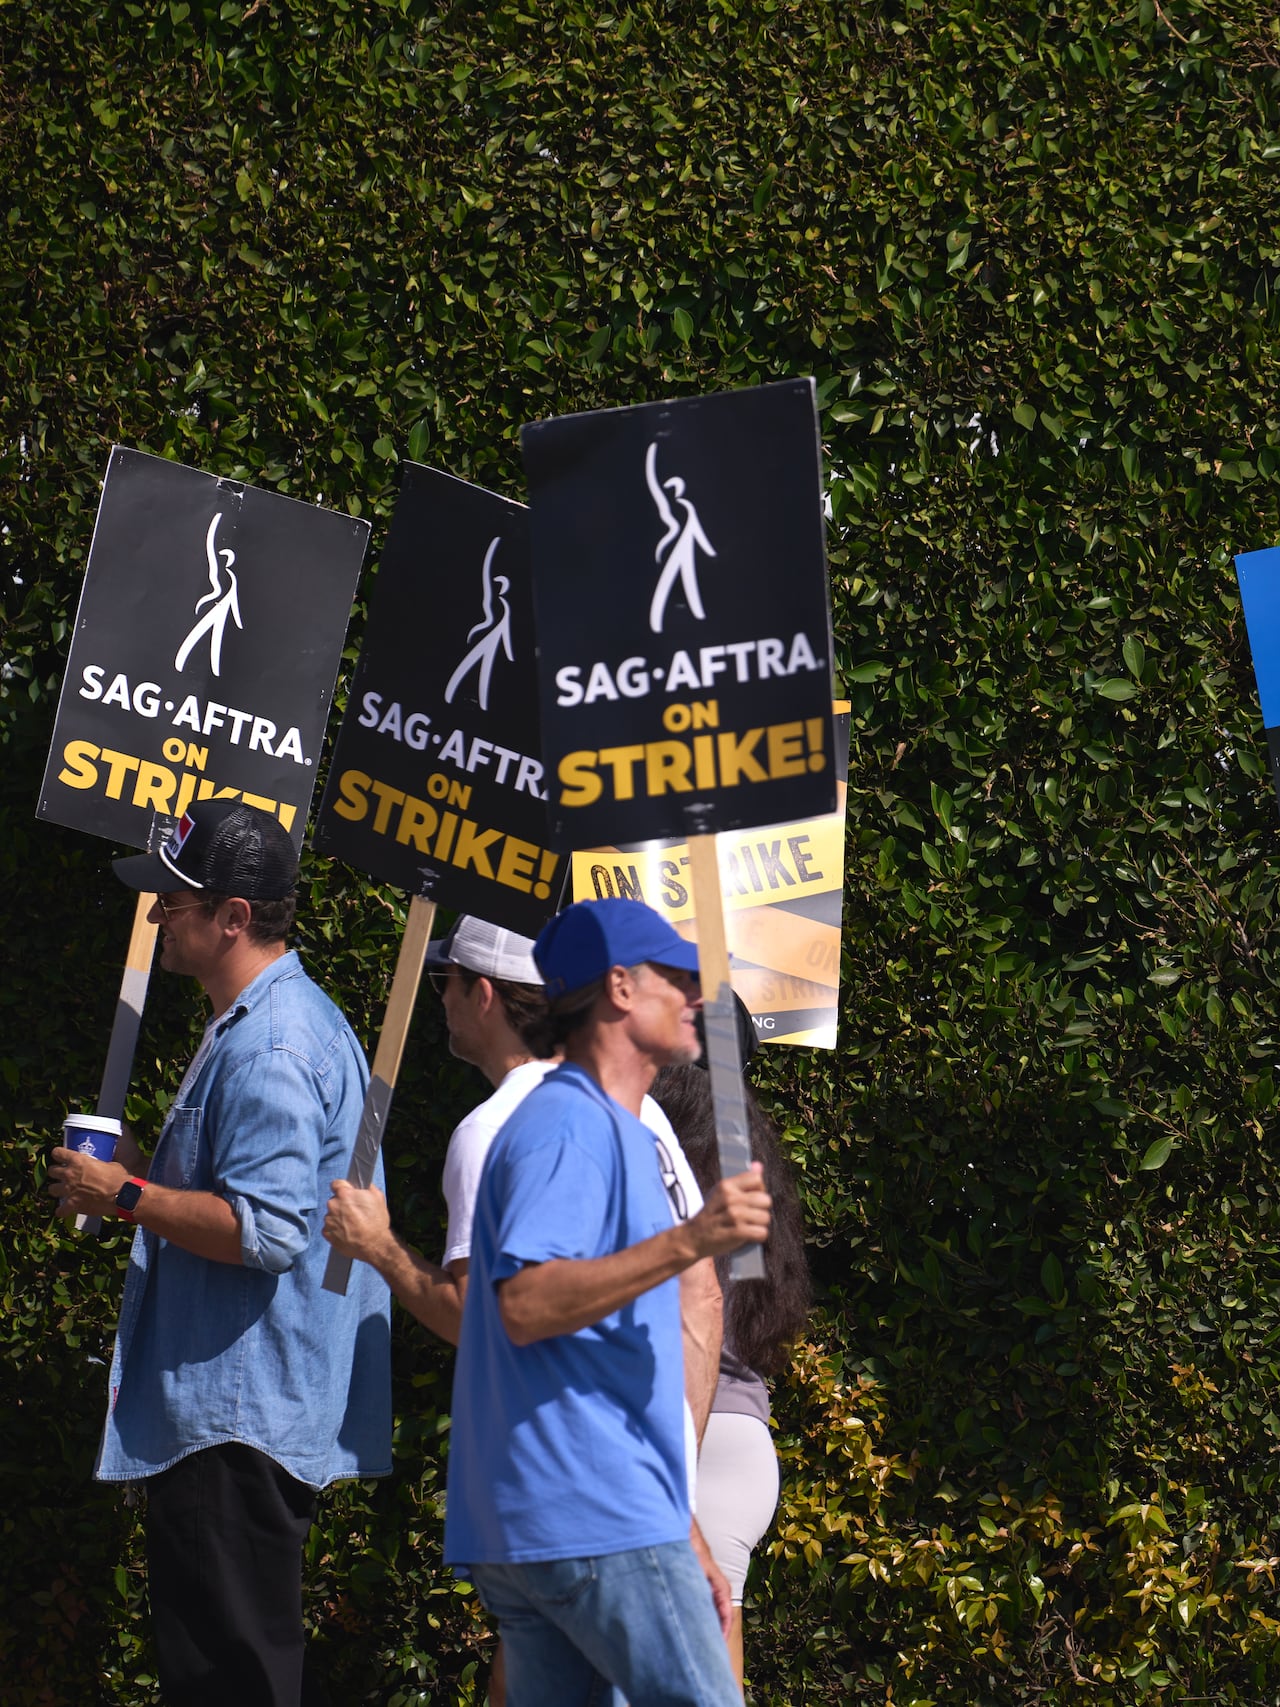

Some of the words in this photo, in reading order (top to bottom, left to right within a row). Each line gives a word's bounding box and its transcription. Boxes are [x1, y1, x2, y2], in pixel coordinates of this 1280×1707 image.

[161, 737, 209, 771] ON
[357, 690, 548, 800] SAG·AFTR
[662, 699, 719, 734] ON
[427, 772, 472, 810] ON
[557, 717, 826, 808] STRIKE!
[332, 769, 559, 901] STRIKE!
[590, 864, 645, 901] ON
[658, 834, 824, 909] SRIKE
